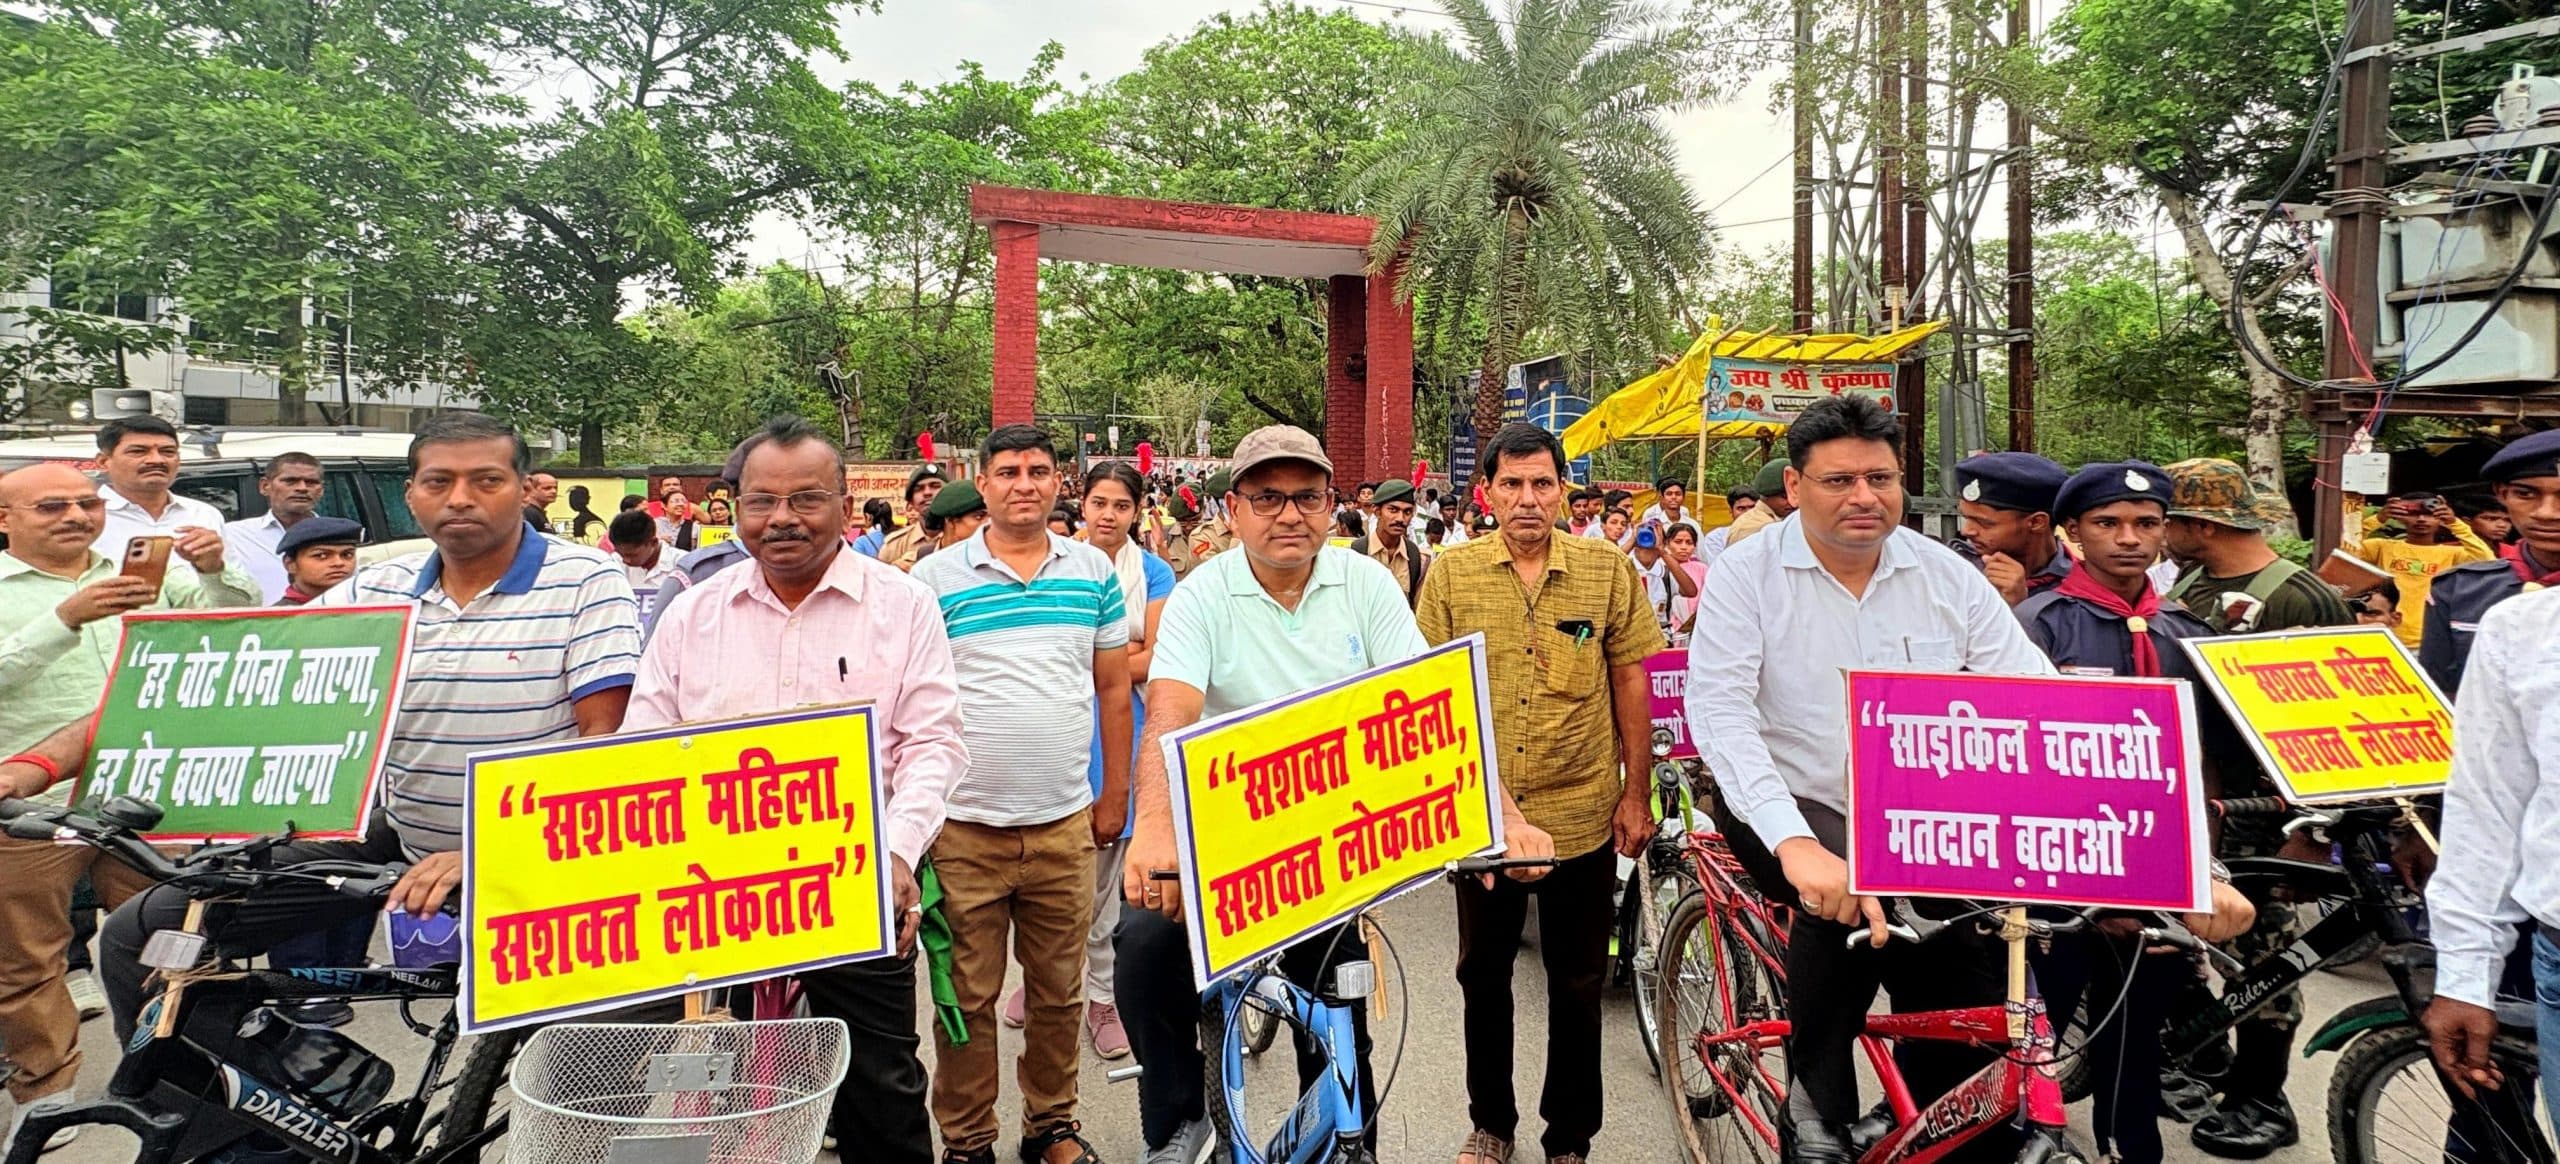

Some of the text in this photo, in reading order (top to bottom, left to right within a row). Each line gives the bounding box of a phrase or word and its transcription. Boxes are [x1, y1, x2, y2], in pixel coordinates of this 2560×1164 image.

[1726, 367, 1892, 396] जय श्री कृष्णा
[177, 635, 229, 709] वोट
[224, 633, 293, 707] गिना
[292, 646, 381, 718] जाएगा,
[2222, 646, 2427, 704] “सशक्त महिला,
[171, 746, 255, 807] बचाया
[252, 730, 368, 807] जाएगा”
[1208, 688, 1467, 822] “सशक्त महिला,
[1861, 700, 2177, 795] “साइकिल चलाओ,
[2263, 726, 2363, 774] सशक्त
[499, 746, 855, 862] “सशक्त महिला,
[1884, 803, 2154, 888] मतदान बढ़ाओ”
[486, 843, 866, 985] सशक्त लोकतंत्र”
[1209, 837, 1325, 938] सशक्त
[241, 1088, 349, 1157] DAZZLER
[1925, 1085, 1983, 1139] HERO
